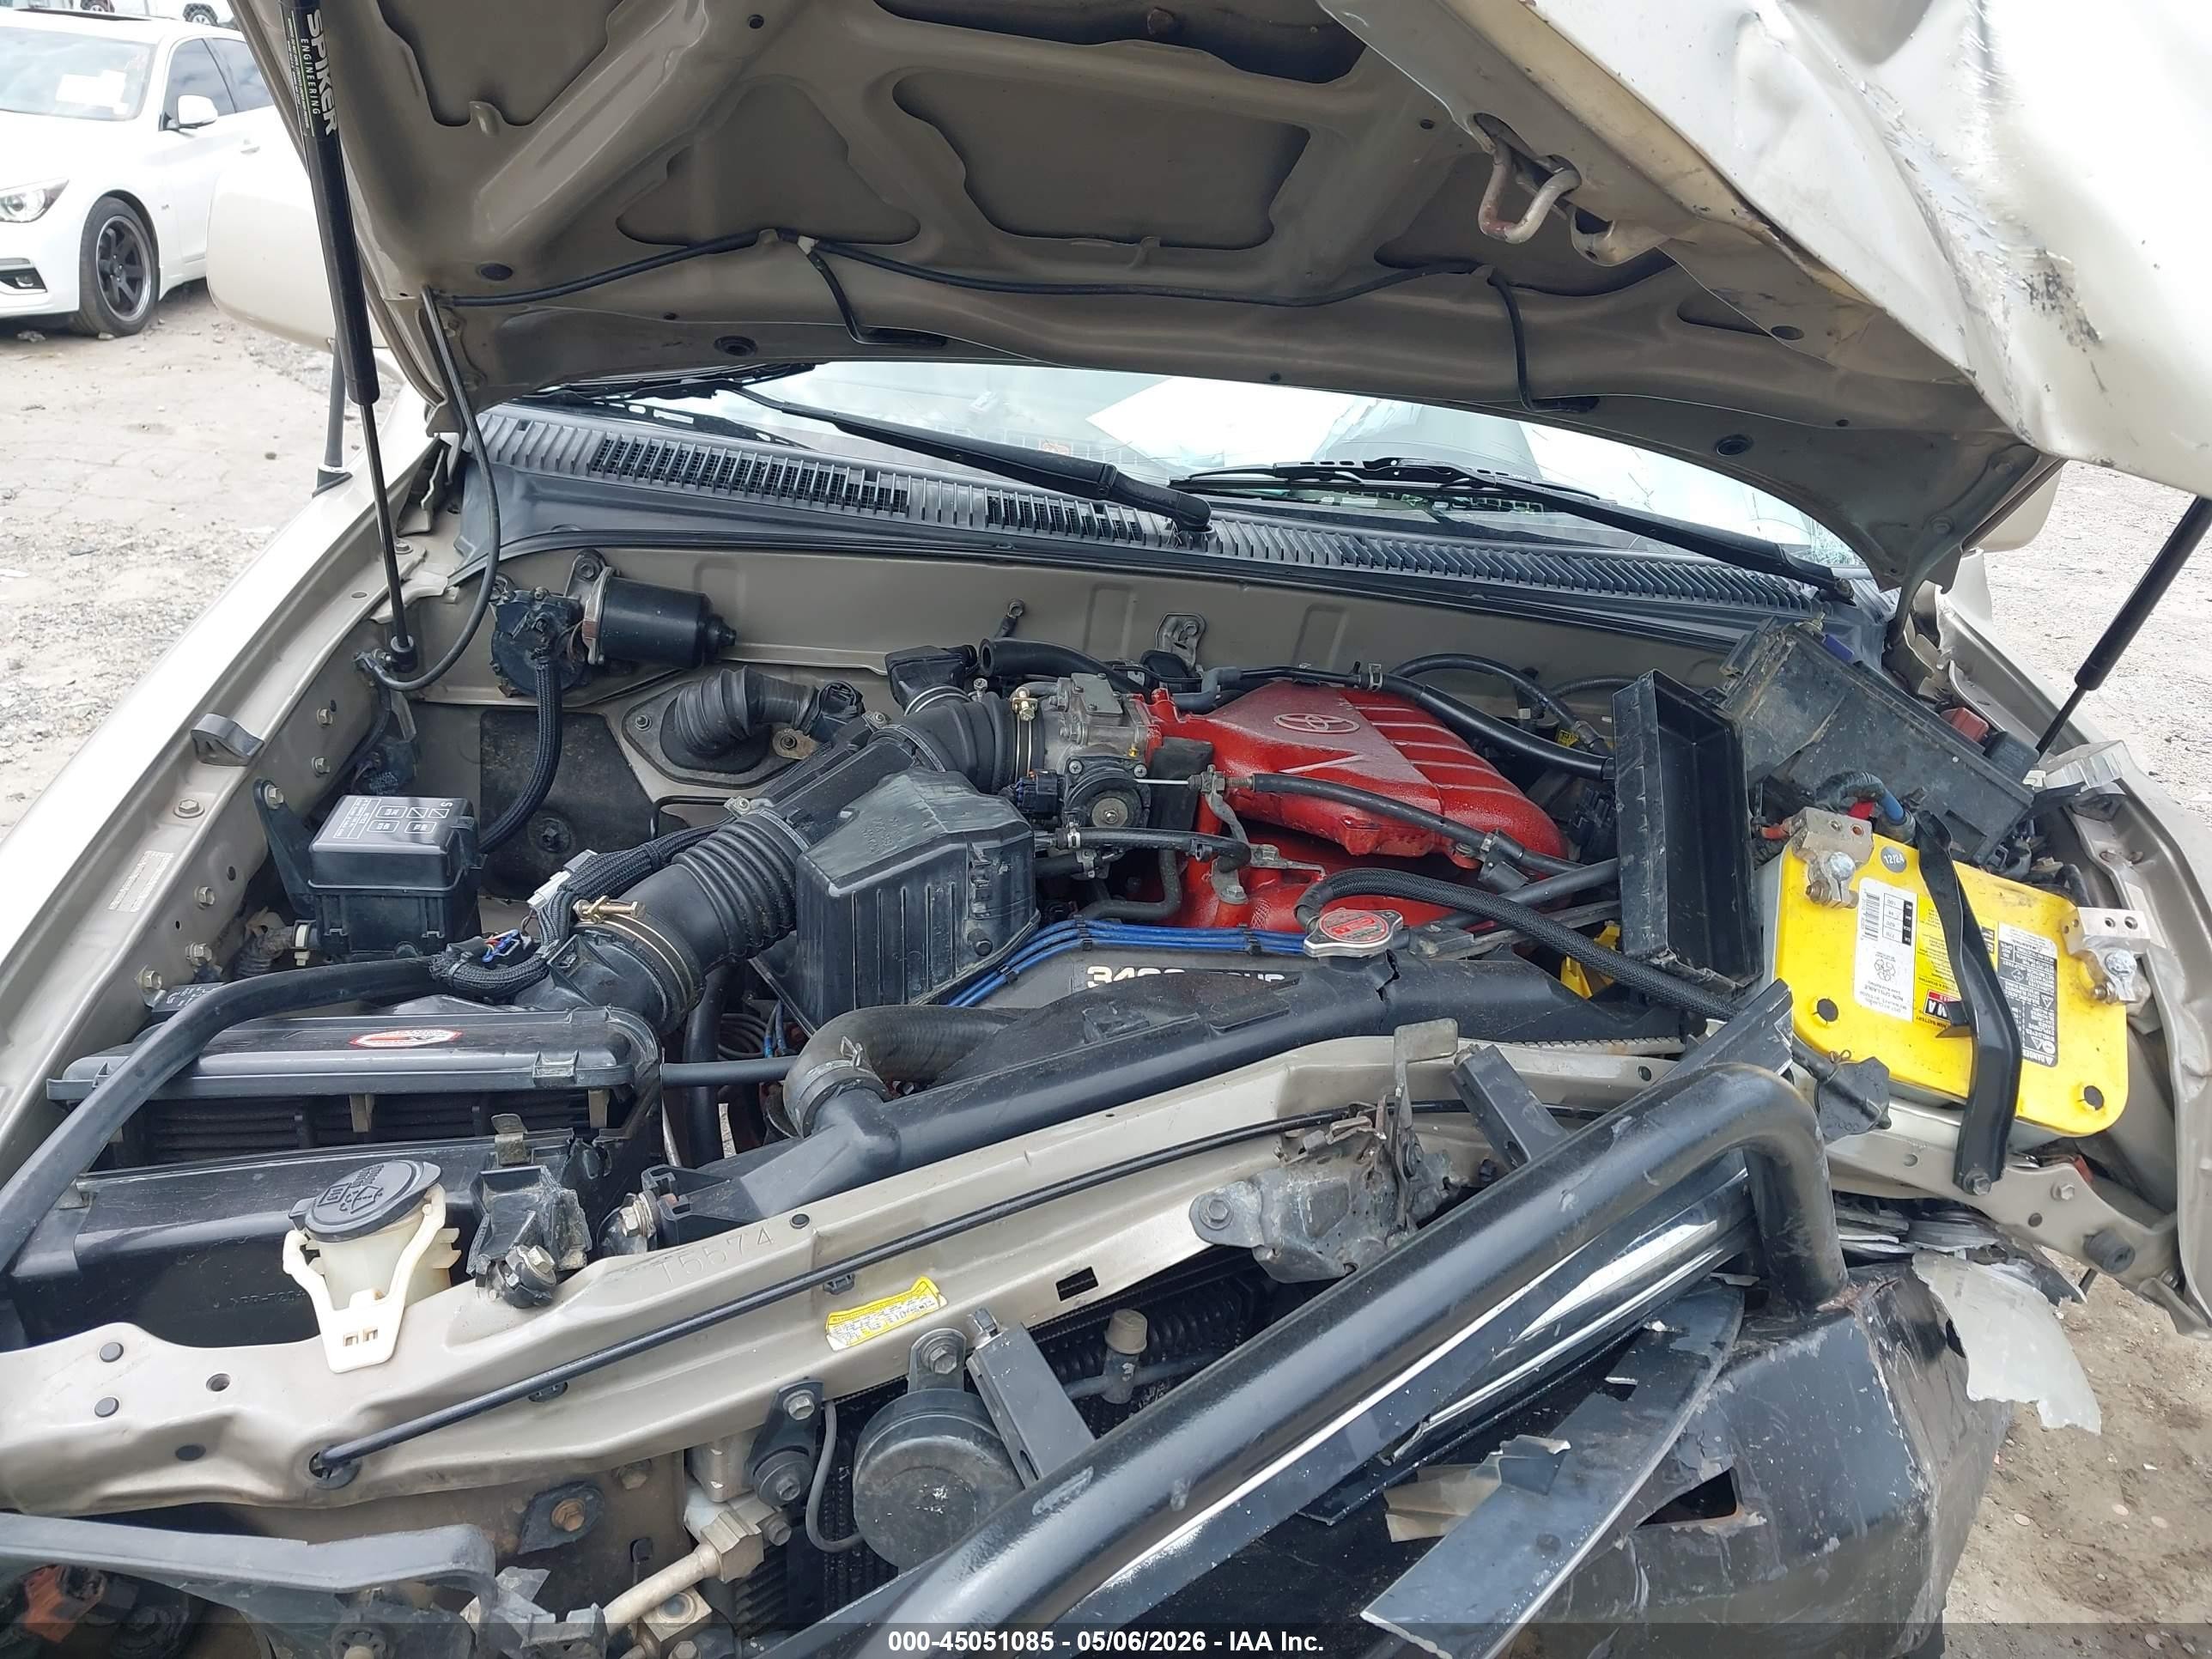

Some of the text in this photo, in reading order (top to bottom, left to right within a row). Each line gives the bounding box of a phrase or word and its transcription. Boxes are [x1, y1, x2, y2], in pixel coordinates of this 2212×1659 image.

[301, 39, 321, 114] ENGINEERING
[307, 9, 338, 136] SPIKER
[1882, 853, 1905, 866] 12/24
